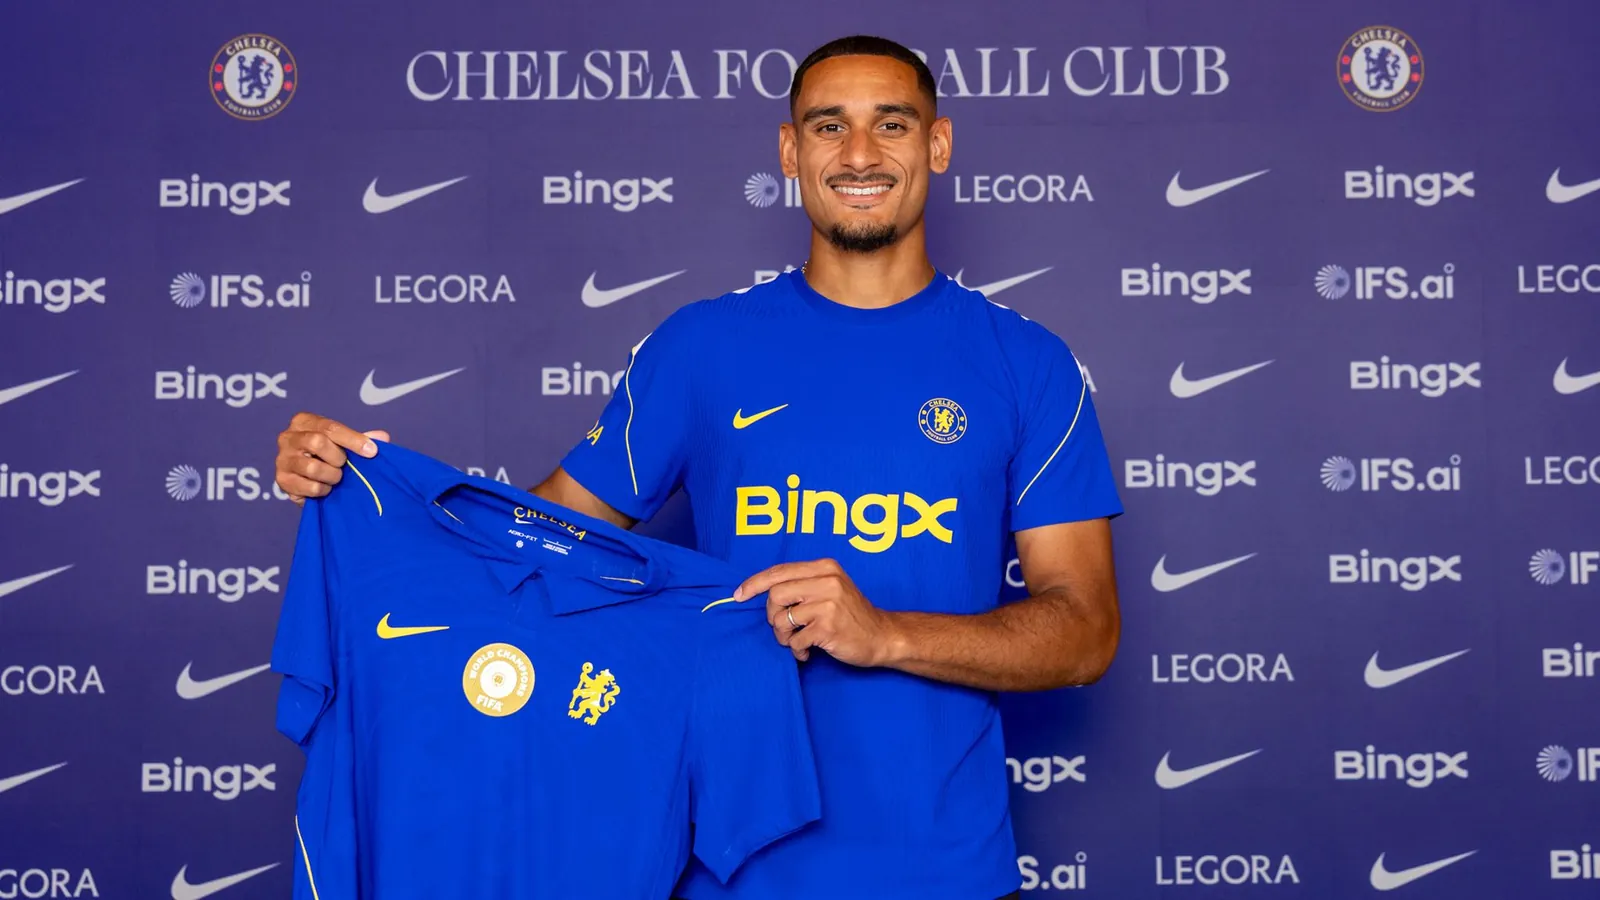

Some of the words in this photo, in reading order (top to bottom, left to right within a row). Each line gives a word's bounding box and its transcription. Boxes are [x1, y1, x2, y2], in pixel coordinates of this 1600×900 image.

[226, 37, 282, 56] CHELSEA
[1351, 29, 1407, 48] CHELSEA
[406, 50, 701, 102] CHELSEA
[713, 47, 1051, 100] FOALL
[1063, 46, 1230, 97] CLUB
[954, 174, 1094, 204] LEGORA
[0, 270, 106, 314] ingx
[210, 271, 312, 308] IFS.ai
[375, 274, 516, 303] LEGORA
[1355, 263, 1455, 300] IFS.ai
[541, 361, 625, 396] Bin
[206, 466, 290, 501] IFS.
[1360, 454, 1461, 492] IFS.ai
[513, 506, 587, 541] CHELSEA
[469, 650, 495, 679] WORLD
[496, 648, 529, 697] CHAMPIONS
[1152, 653, 1294, 683] LEGORA
[475, 694, 504, 713] FIFA
[1156, 855, 1299, 885] LEGORA
